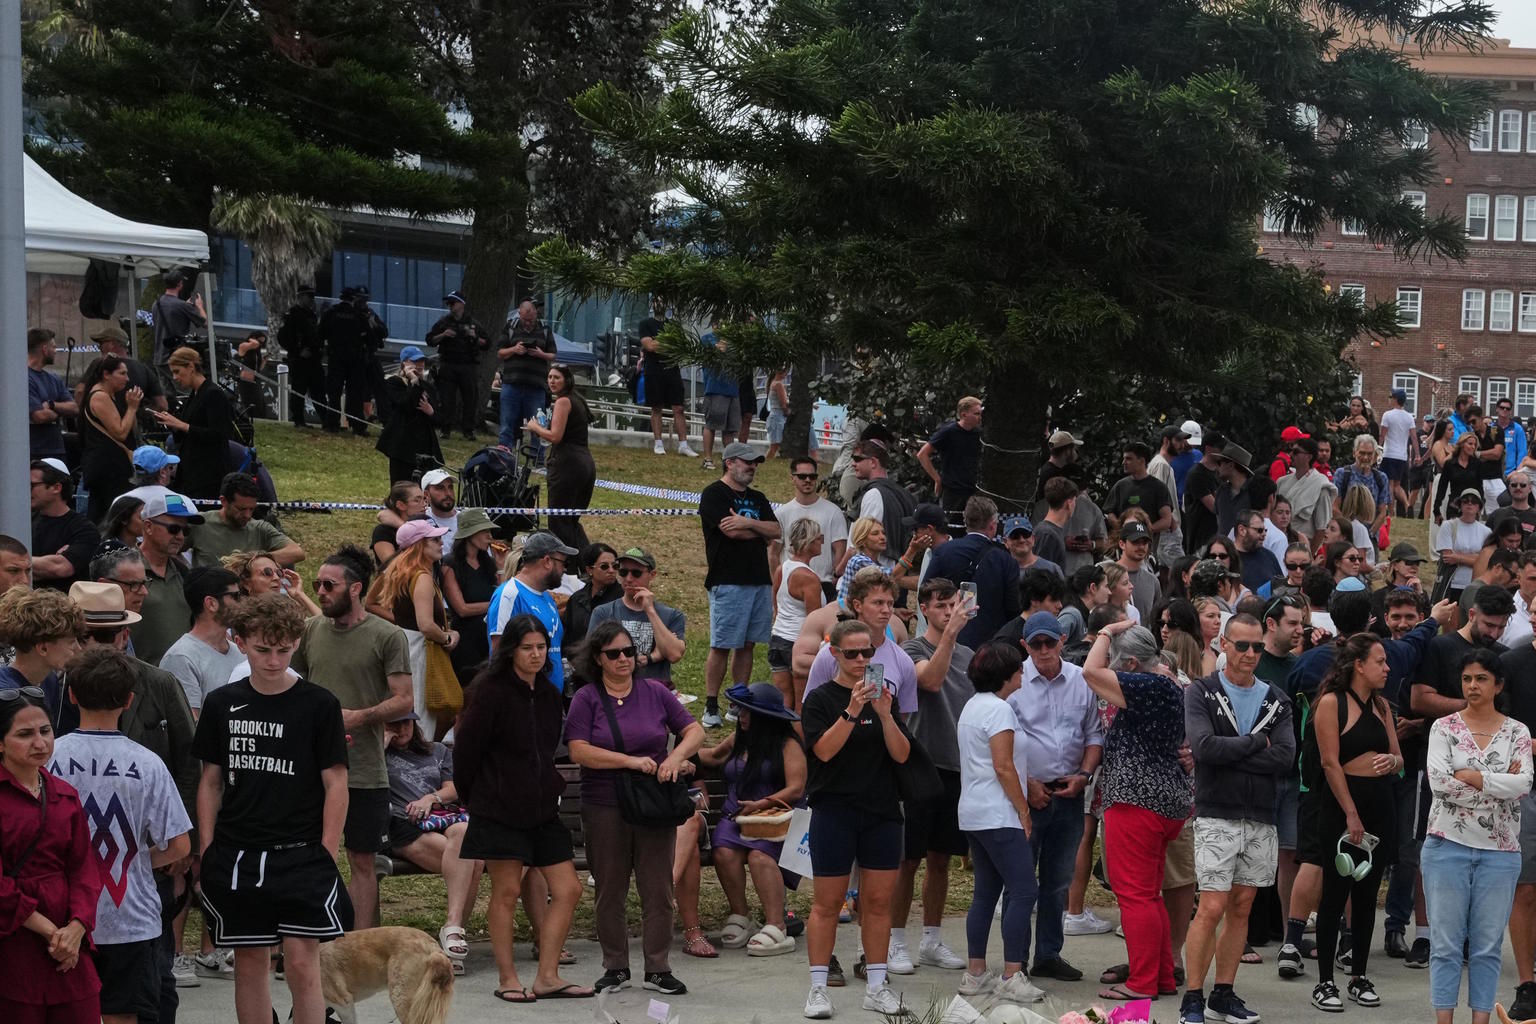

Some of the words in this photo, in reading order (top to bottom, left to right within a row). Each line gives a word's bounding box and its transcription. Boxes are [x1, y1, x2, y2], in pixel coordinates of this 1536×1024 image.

[229, 719, 284, 738] BROOKLYN
[229, 737, 256, 752] NETS
[229, 753, 295, 775] BASKETBALL
